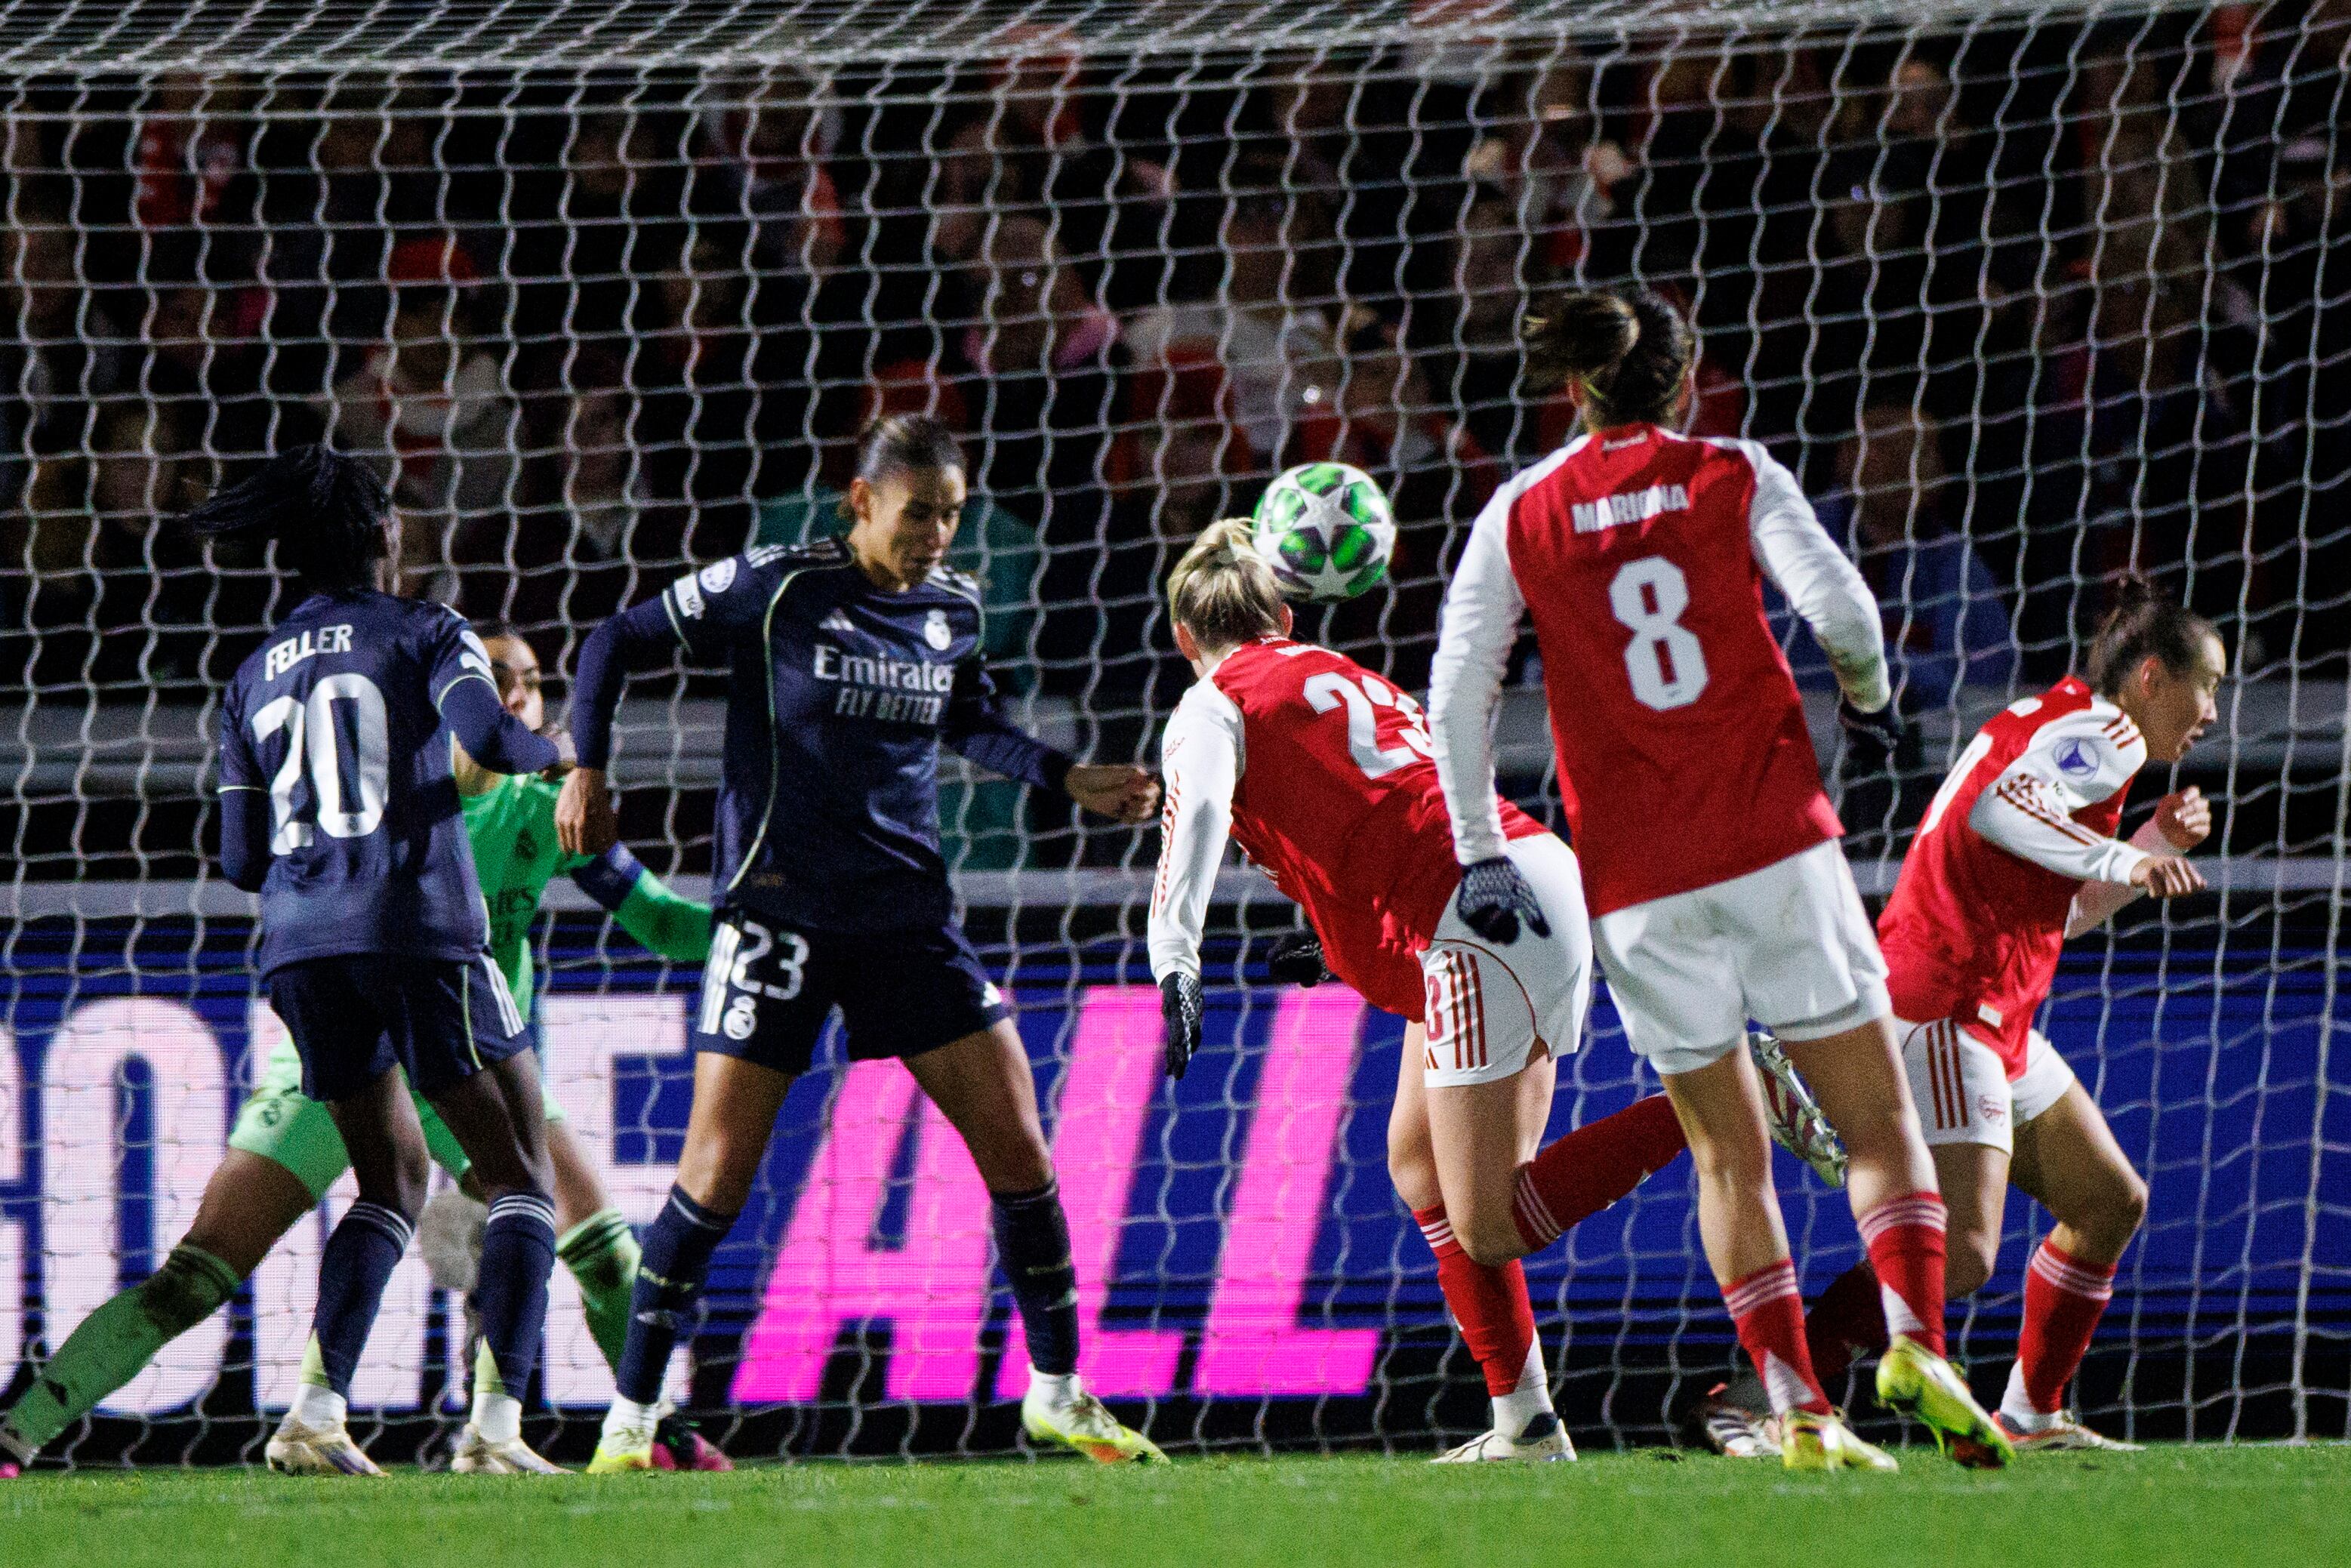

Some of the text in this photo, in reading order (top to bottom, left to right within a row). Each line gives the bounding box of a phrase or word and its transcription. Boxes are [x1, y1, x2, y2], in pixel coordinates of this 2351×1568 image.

[265, 624, 353, 681] FELLER
[1609, 555, 1709, 711] 8
[251, 672, 389, 855] 20
[729, 920, 809, 1000] 23
[729, 984, 1382, 1403] ALL
